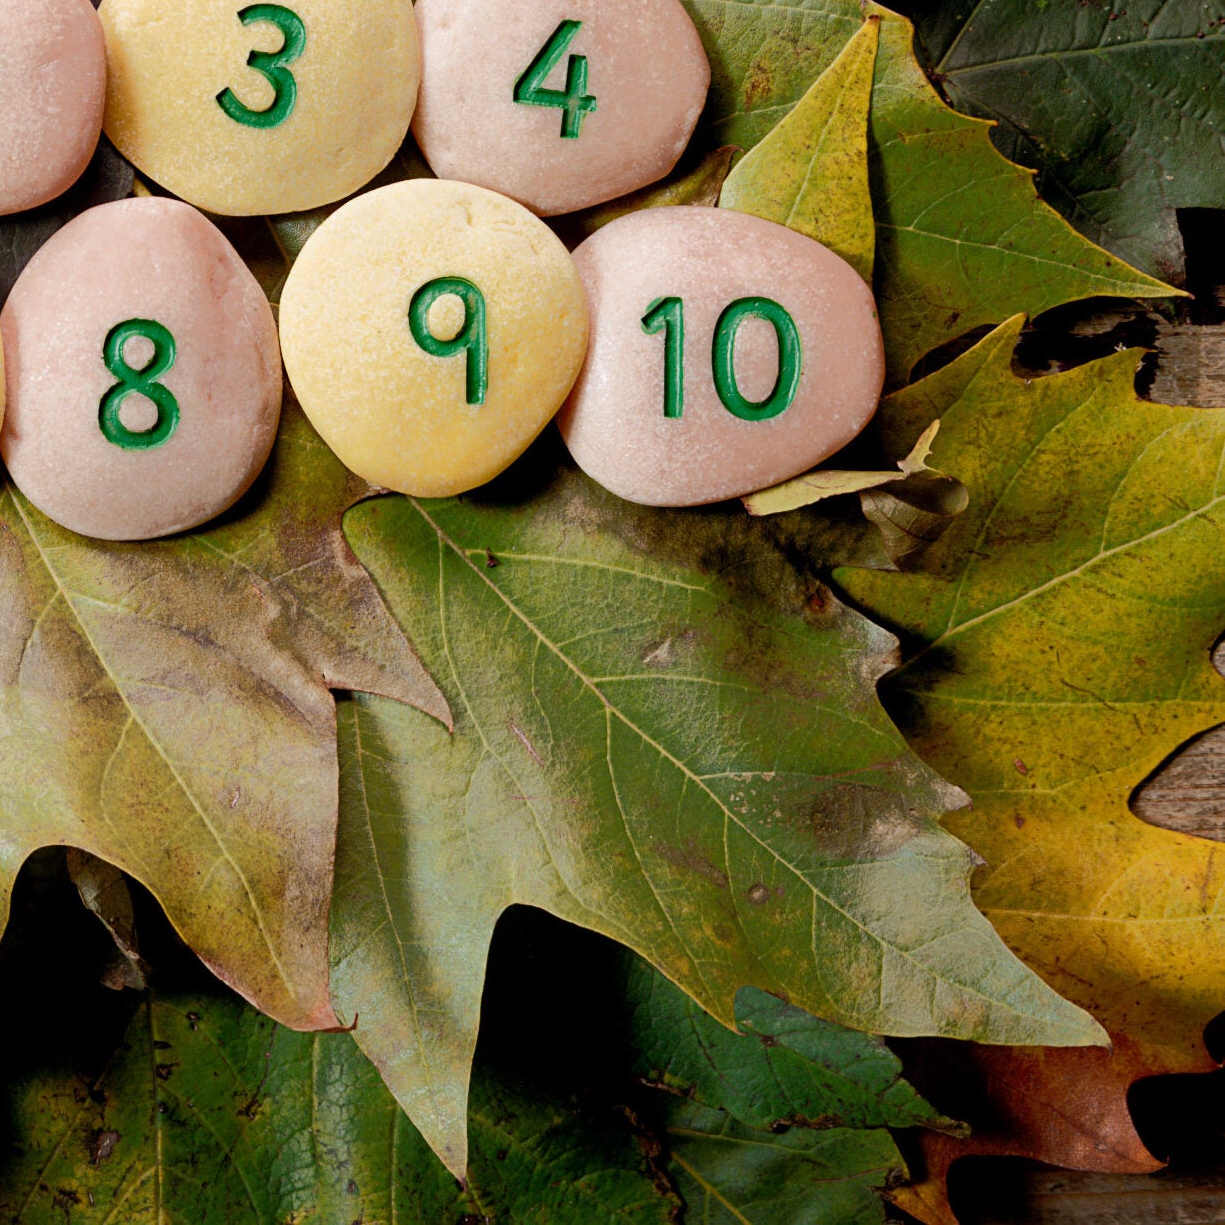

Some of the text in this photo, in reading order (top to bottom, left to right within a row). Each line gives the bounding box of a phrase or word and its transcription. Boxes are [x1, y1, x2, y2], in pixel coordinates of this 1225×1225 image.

[215, 5, 307, 130] 3
[514, 21, 597, 139] 4
[101, 319, 180, 450] 8
[409, 277, 488, 405] 9
[641, 297, 802, 422] 10
